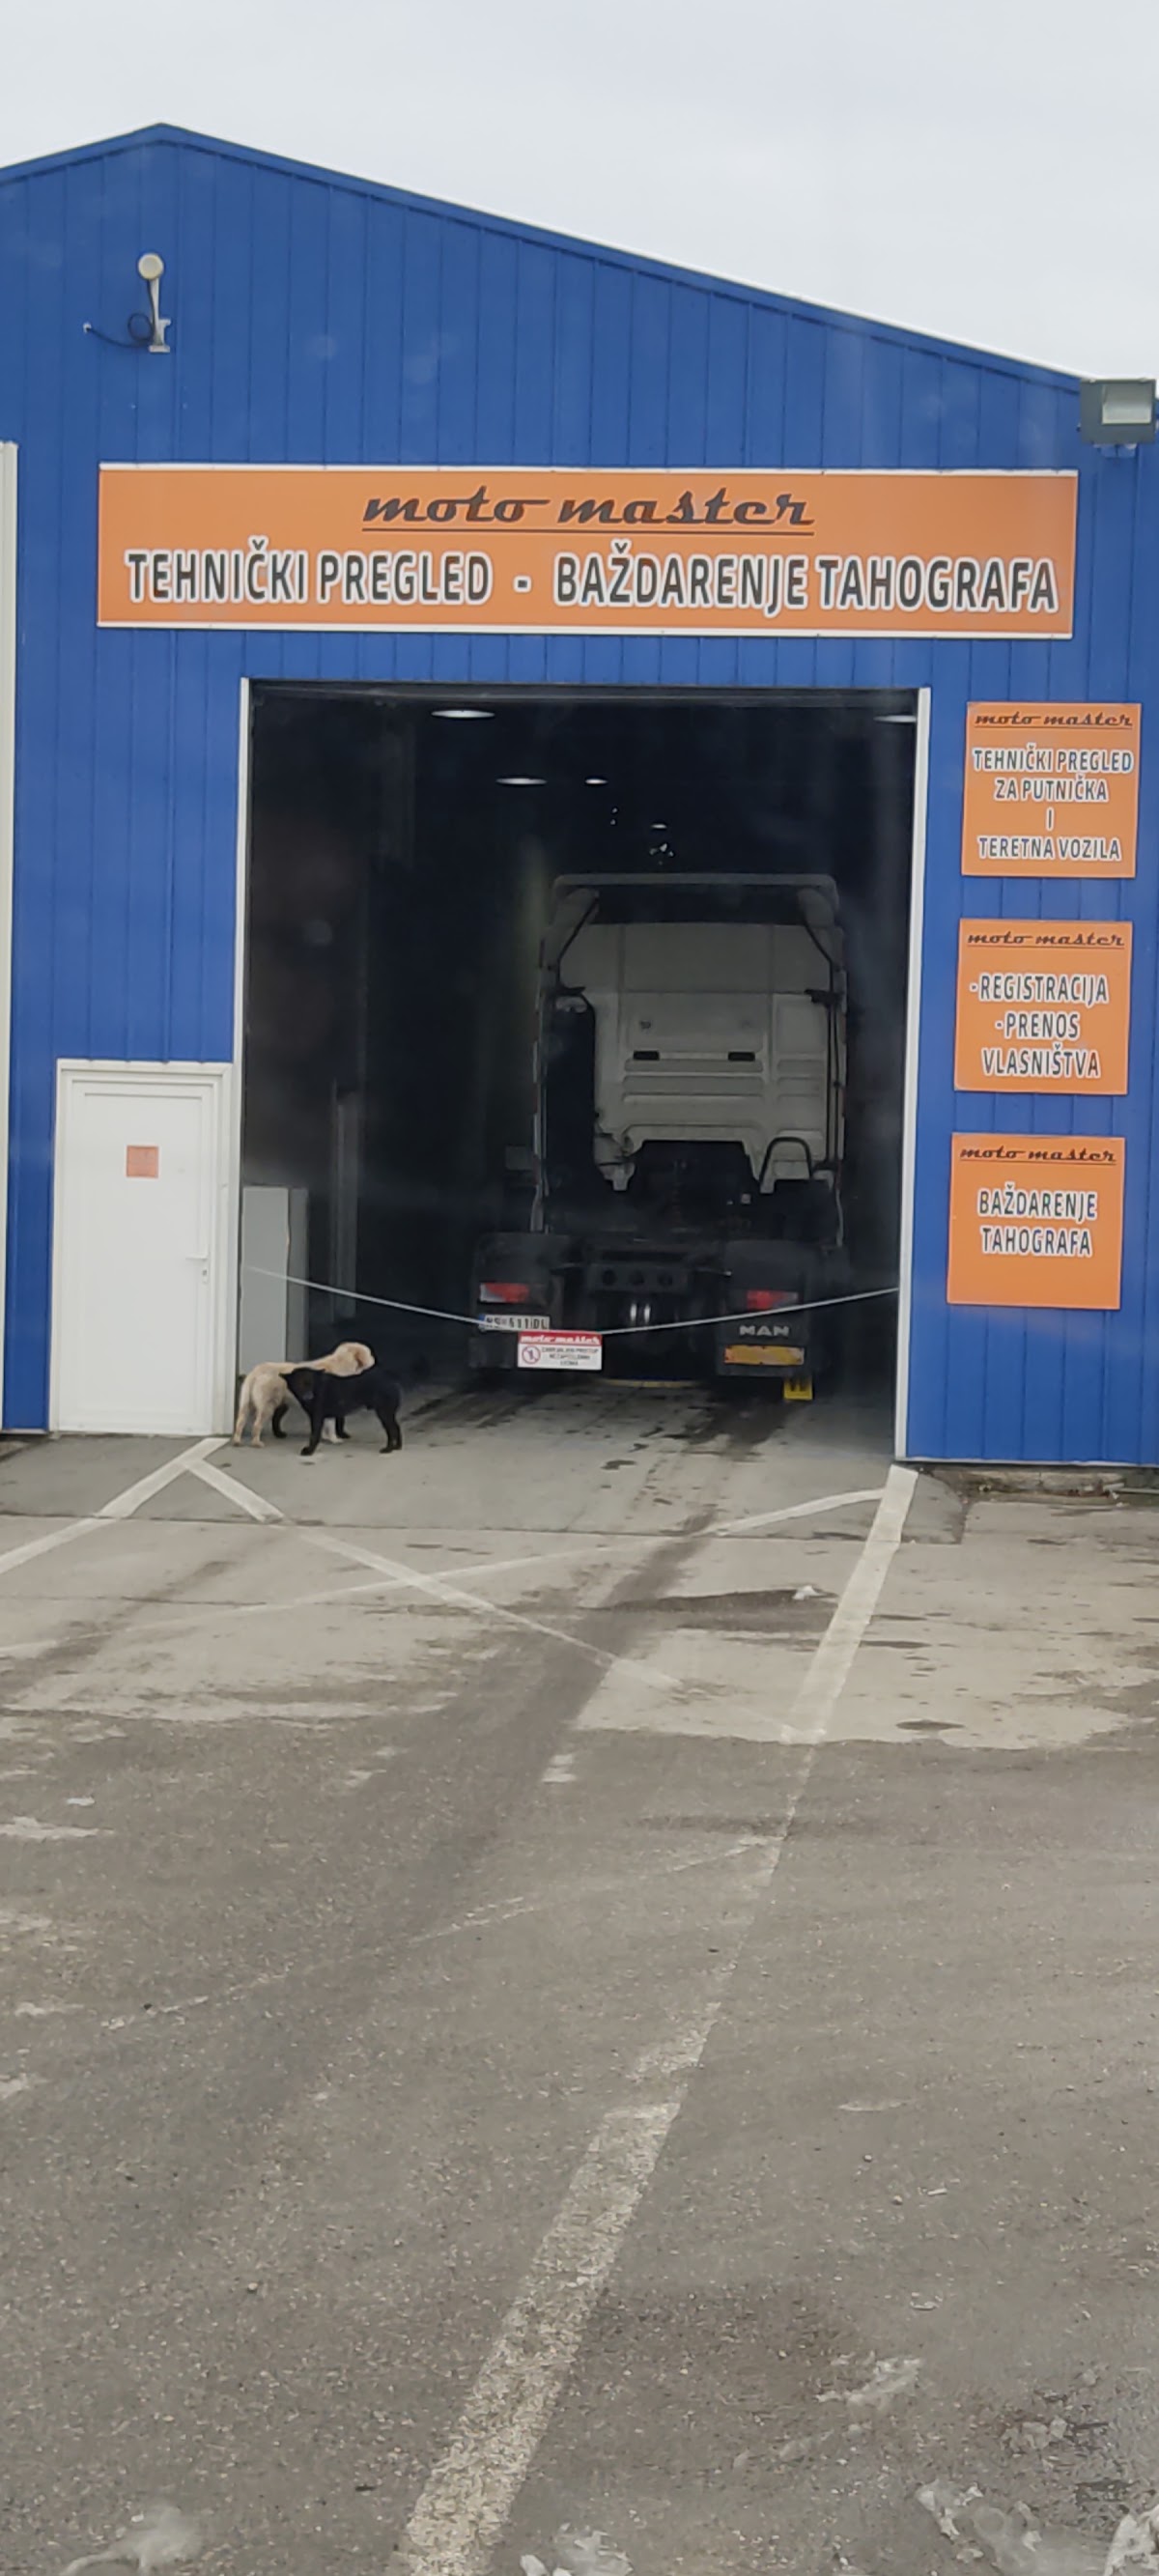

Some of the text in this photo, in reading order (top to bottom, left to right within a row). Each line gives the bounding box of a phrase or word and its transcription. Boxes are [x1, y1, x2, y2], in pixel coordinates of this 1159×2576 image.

[362, 485, 815, 526] moto master
[127, 536, 307, 603] TEHNIČKI
[319, 552, 493, 605] PREGLED
[554, 540, 807, 617] BAŽDARENJE
[817, 556, 1058, 611] TAHOGRAFA
[975, 711, 1132, 726] moto master
[974, 744, 1133, 773] TEHNIČKI PREGLED
[995, 775, 1108, 802] ZA PUTNIČKA
[1047, 807, 1054, 830] I
[978, 836, 1120, 861] TERETNA VOZILA
[968, 931, 1124, 947] moto master
[982, 1042, 1100, 1077] VLASNIŠTVA
[960, 1146, 1117, 1162] moto master
[978, 1181, 1096, 1223] BAŽDARENJE
[980, 1225, 1092, 1257] TAHOGRAFA
[739, 1325, 790, 1337] MAN
